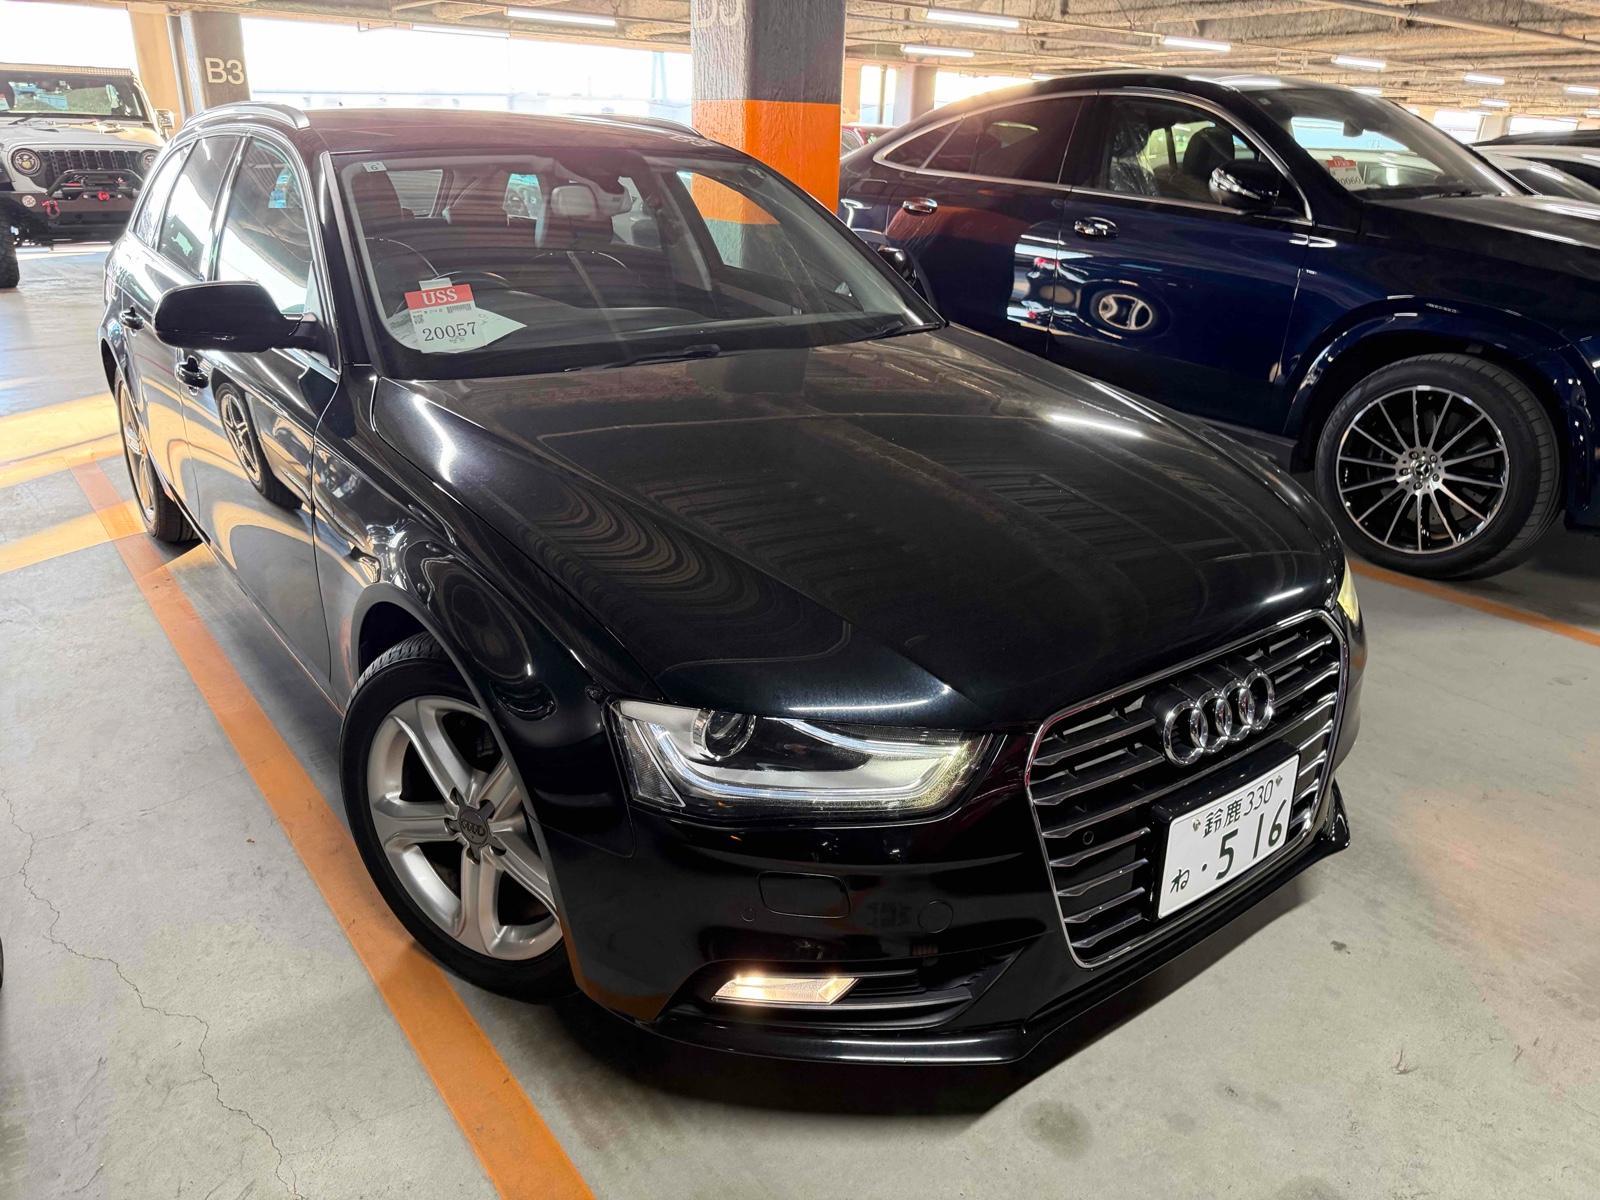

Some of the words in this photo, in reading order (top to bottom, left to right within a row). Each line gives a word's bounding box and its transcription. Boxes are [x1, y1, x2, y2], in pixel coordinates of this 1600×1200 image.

[205, 57, 245, 85] B3
[422, 288, 458, 305] USS
[422, 321, 476, 342] 20057
[1170, 868, 1190, 894] ね
